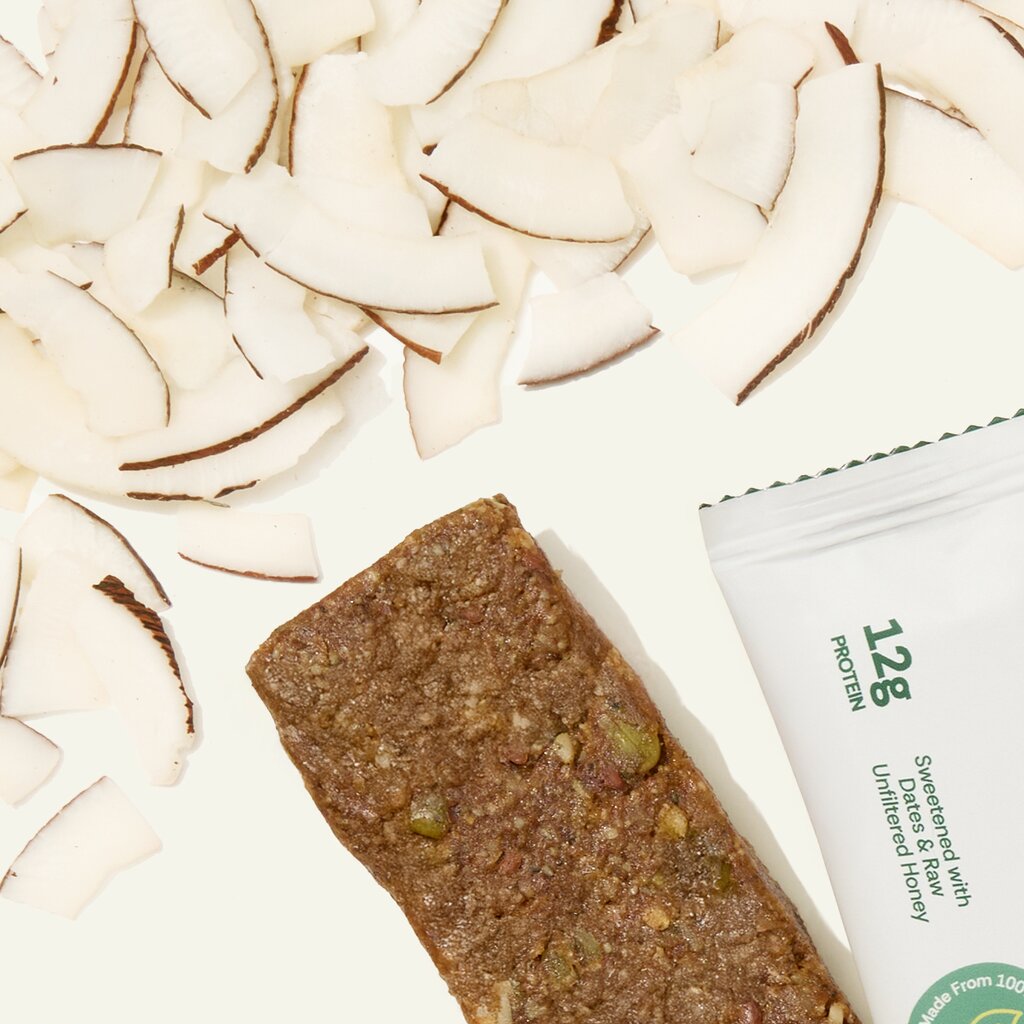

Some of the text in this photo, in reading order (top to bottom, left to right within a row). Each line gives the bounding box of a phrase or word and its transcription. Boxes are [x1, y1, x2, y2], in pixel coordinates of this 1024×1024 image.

[830, 634, 867, 712] PROTEIN
[863, 618, 912, 708] 12g
[872, 763, 930, 923] Unfiltered Honey
[898, 777, 945, 897] Dates & Raw
[914, 755, 972, 908] Sweetened with
[950, 976, 993, 996] From
